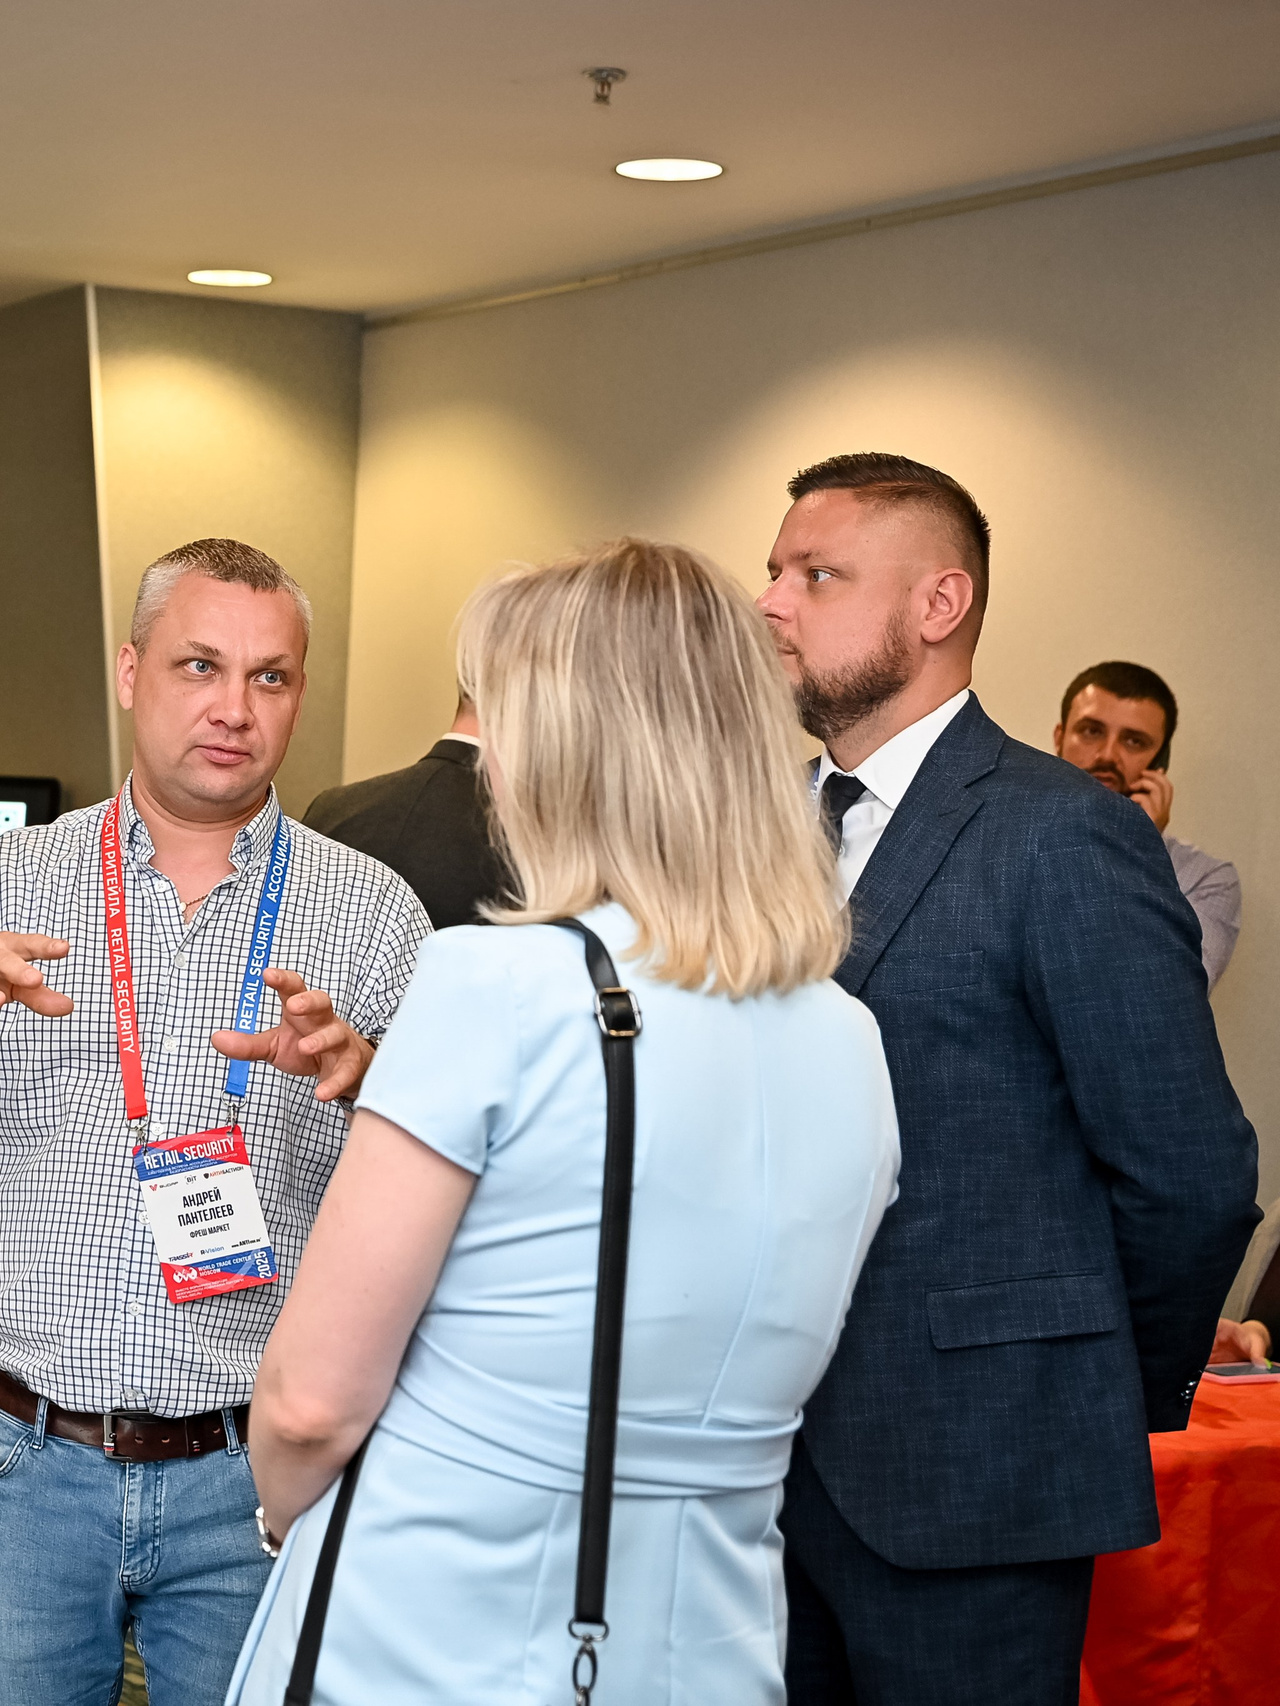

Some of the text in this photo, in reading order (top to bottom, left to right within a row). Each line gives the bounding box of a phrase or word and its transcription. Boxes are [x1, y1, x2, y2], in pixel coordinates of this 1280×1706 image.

[105, 851, 121, 918] РИТЕЙЛА
[238, 910, 274, 1031] RETAIL SECURITY
[110, 928, 135, 1054] RETAIL SECURITY
[143, 1137, 235, 1170] RETAIL SECURITY
[182, 1187, 222, 1208] АНДРЕЙ
[178, 1204, 234, 1227] ПАНТЕЛЕЕВ
[190, 1223, 230, 1238] ФРЕШ МАРКЕТ
[198, 1255, 252, 1272] WORLD TRADE CENTER
[199, 1268, 221, 1276] MOSCOW
[254, 1250, 272, 1279] 2025
